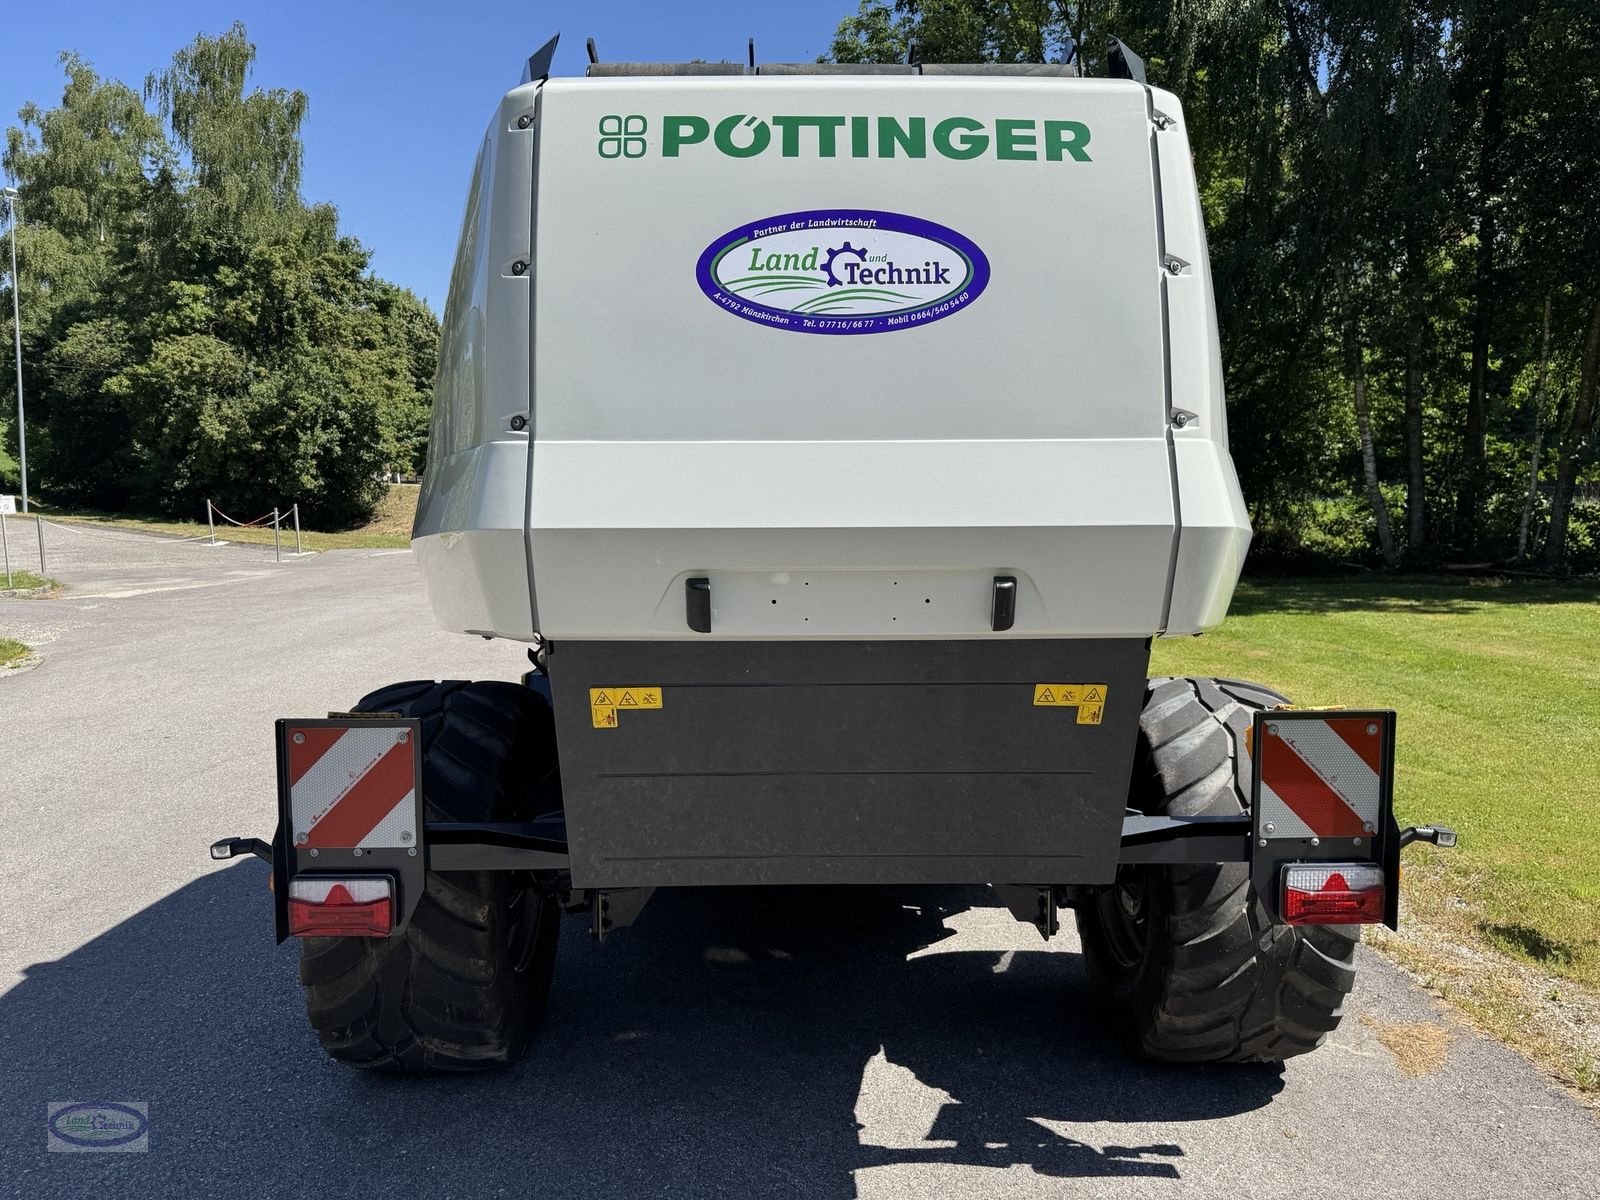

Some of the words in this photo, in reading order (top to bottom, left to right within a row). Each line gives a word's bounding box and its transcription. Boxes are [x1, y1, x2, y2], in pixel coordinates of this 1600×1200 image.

[662, 114, 1094, 162] PÖTTINGER
[753, 224, 788, 238] Partner
[790, 221, 805, 230] der
[808, 218, 877, 229] Landwirtschaft
[748, 247, 819, 272] Land
[869, 254, 888, 263] und
[845, 262, 951, 285] Technik
[713, 292, 740, 311] A-4792
[741, 306, 790, 325] Münzkirchen
[803, 319, 817, 328] Tel.
[888, 315, 909, 326] Mobil
